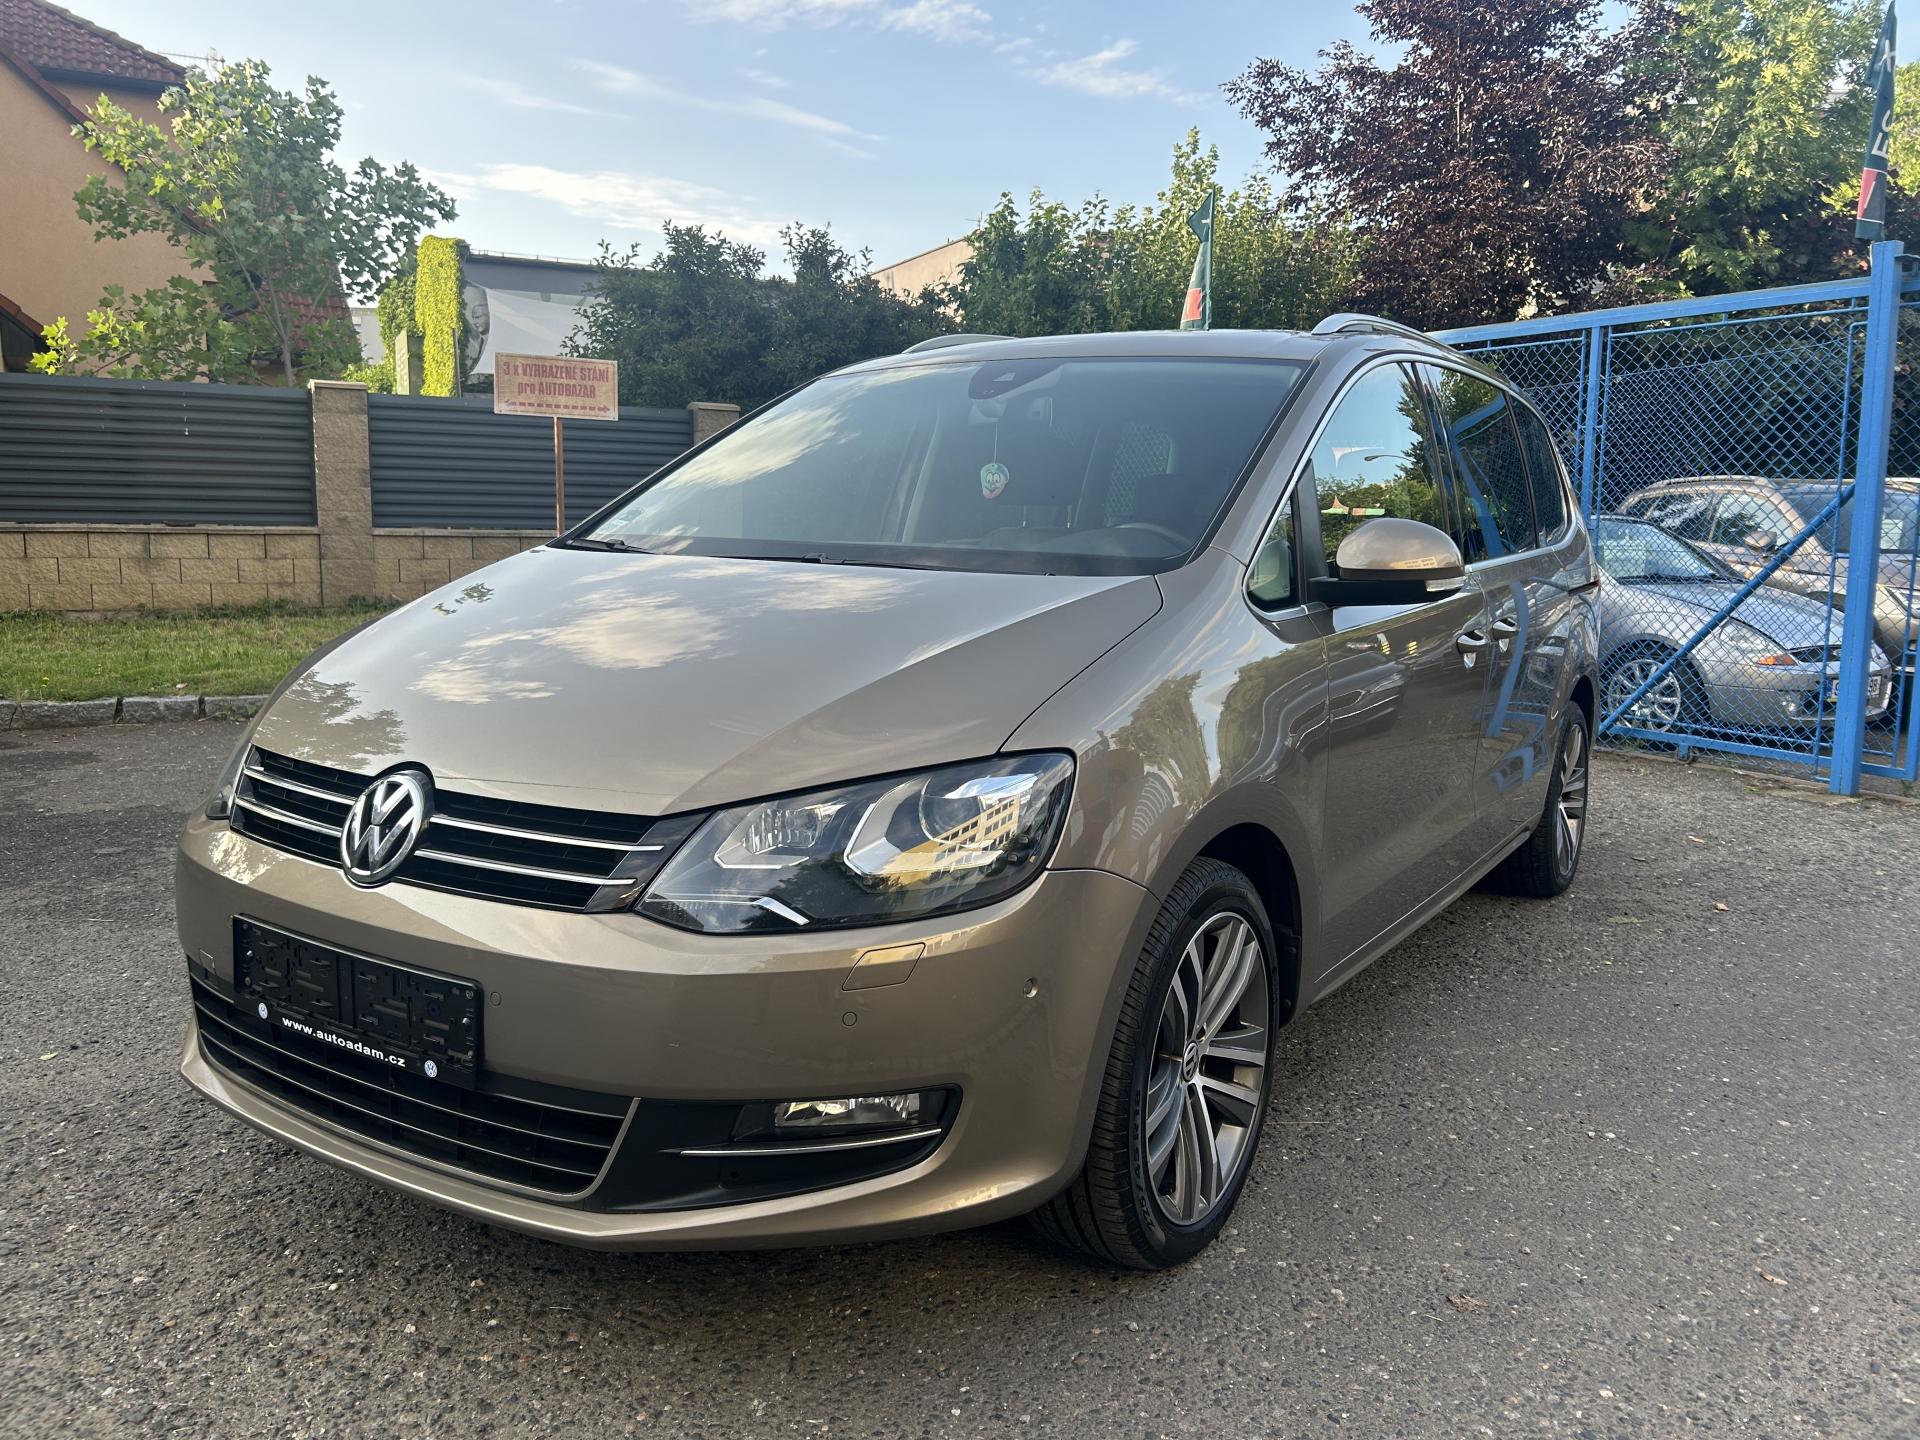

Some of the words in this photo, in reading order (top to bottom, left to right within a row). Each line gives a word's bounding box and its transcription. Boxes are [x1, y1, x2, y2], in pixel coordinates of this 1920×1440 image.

[503, 361, 511, 376] 3
[517, 382, 535, 396] pro
[538, 382, 596, 399] AUTOBAZAR
[282, 1017, 406, 1068] www.autoadam.cz
